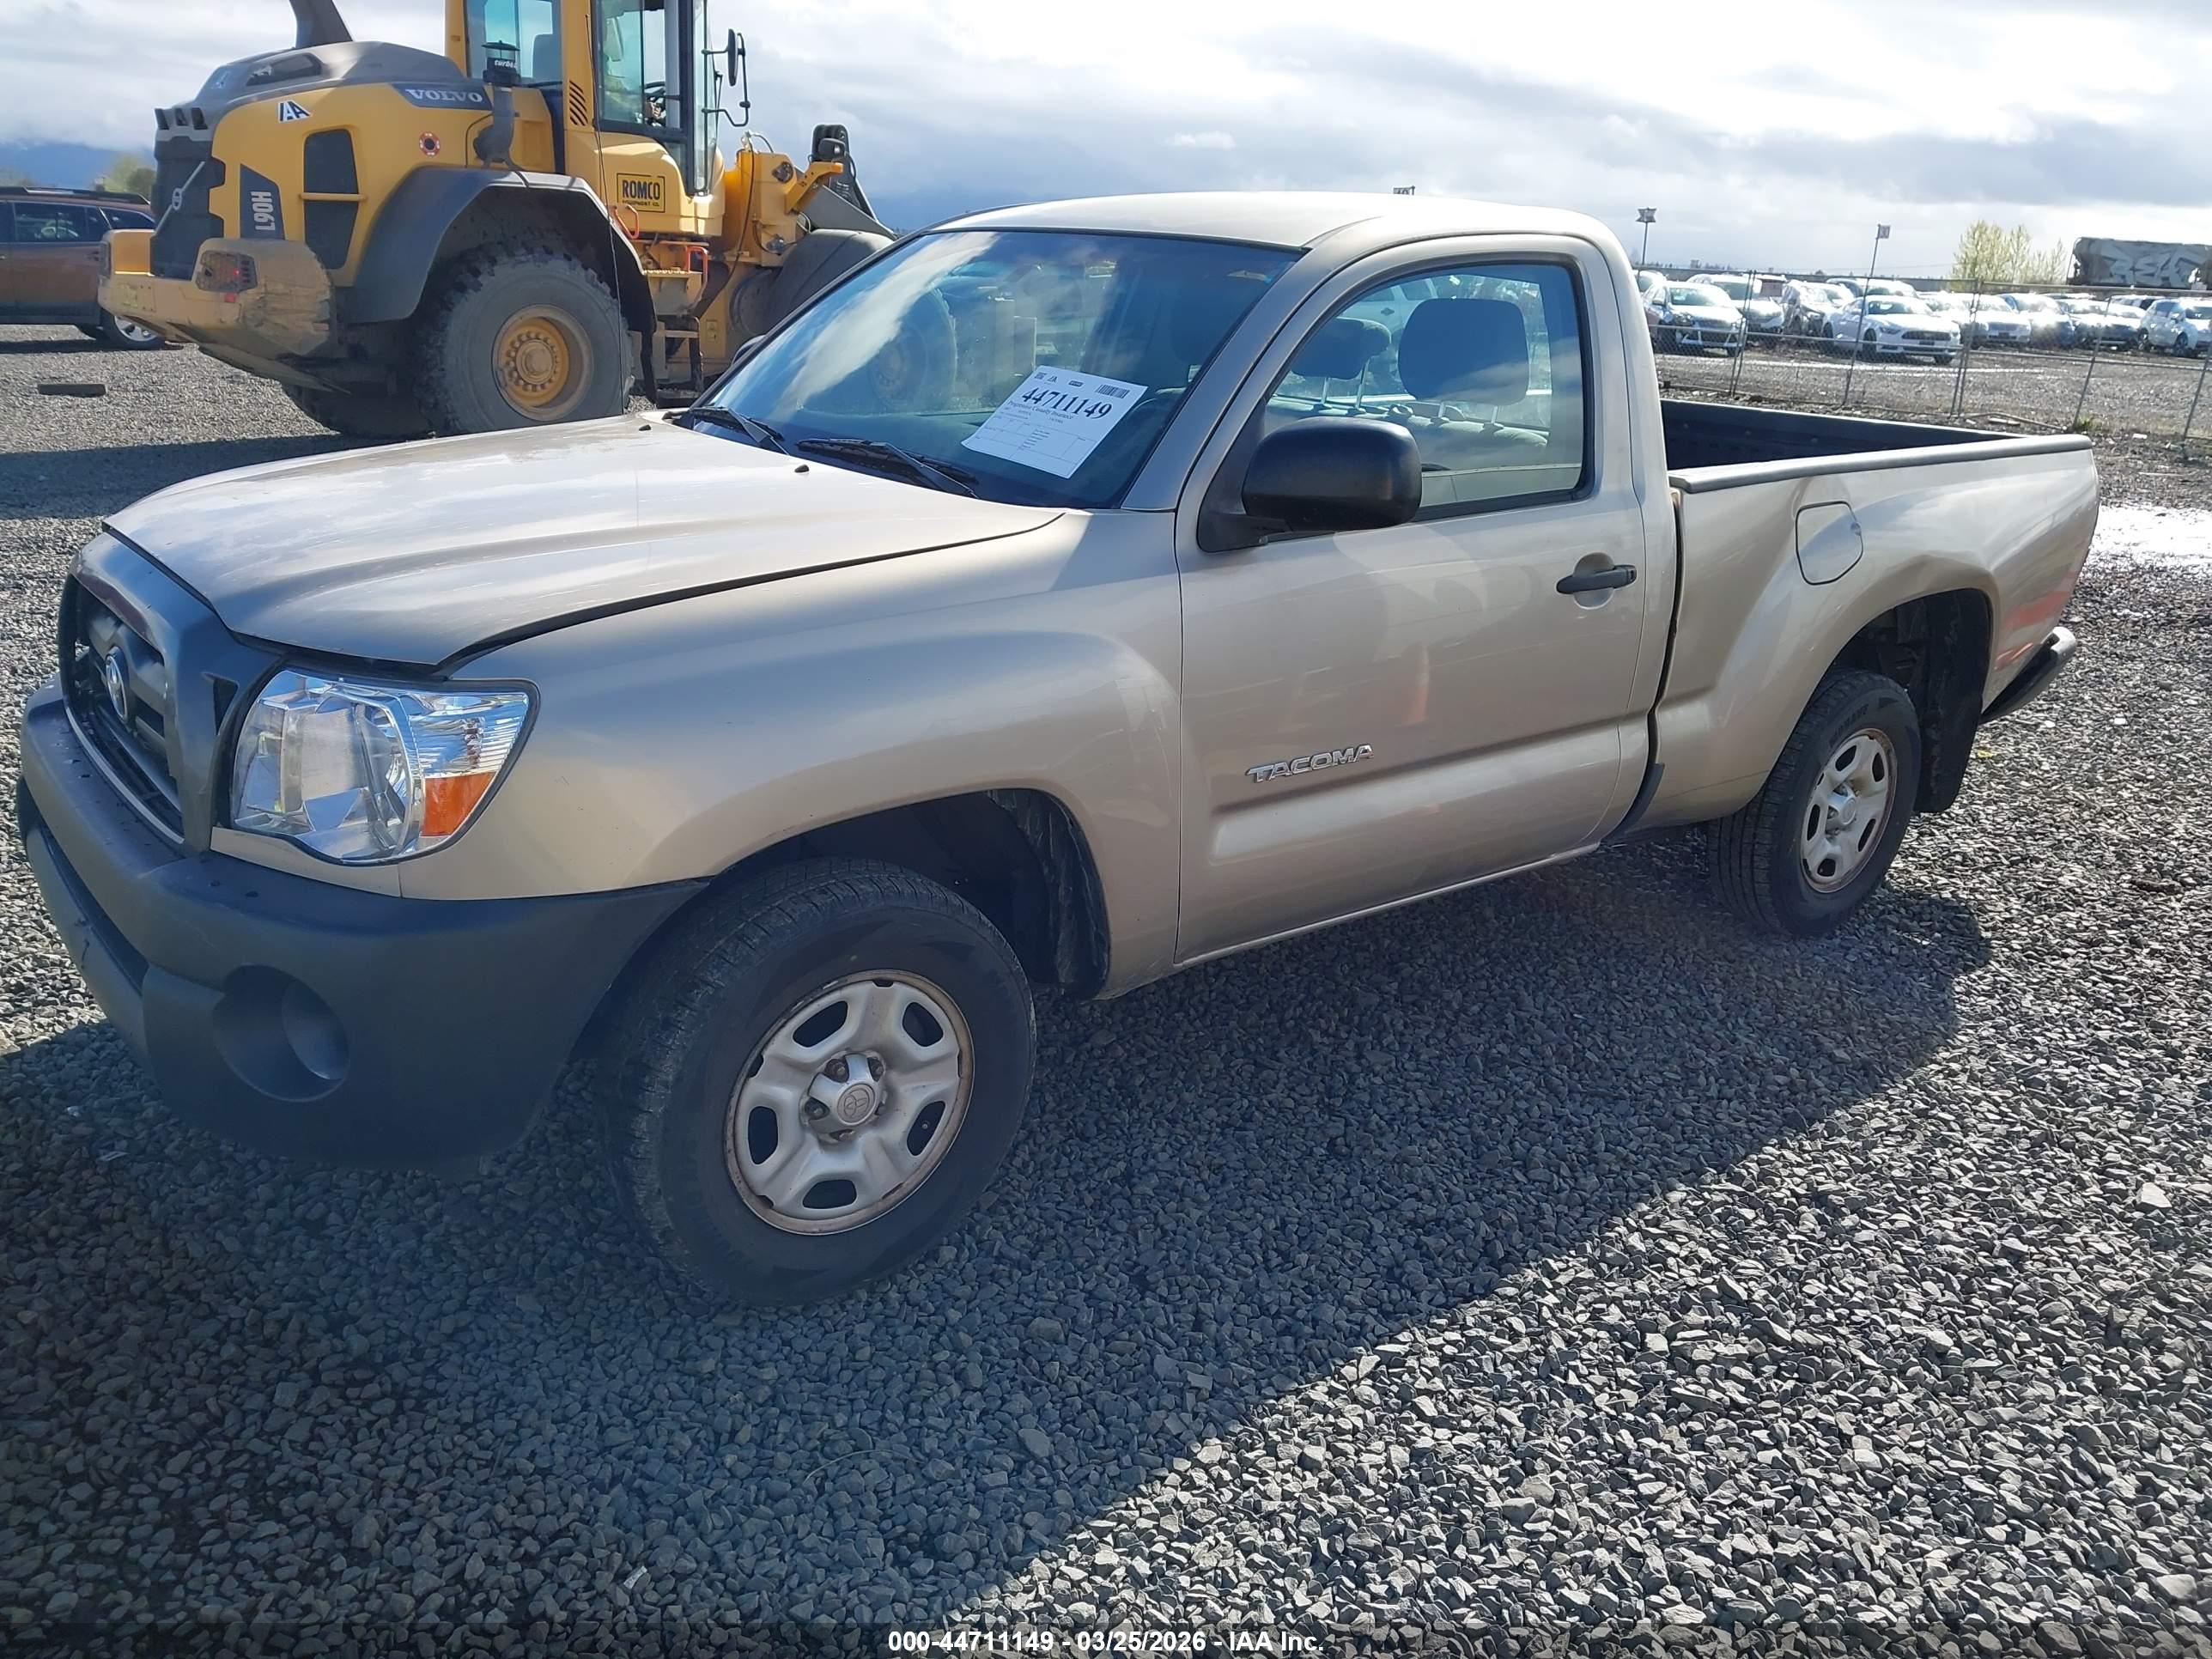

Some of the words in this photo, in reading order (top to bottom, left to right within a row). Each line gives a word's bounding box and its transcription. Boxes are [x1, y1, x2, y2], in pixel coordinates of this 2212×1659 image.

[405, 88, 483, 103] VOLVO
[622, 179, 660, 200] ROMCO
[250, 191, 276, 231] L90H
[1021, 386, 1113, 419] 44711149
[1245, 743, 1375, 784] TACOMA
